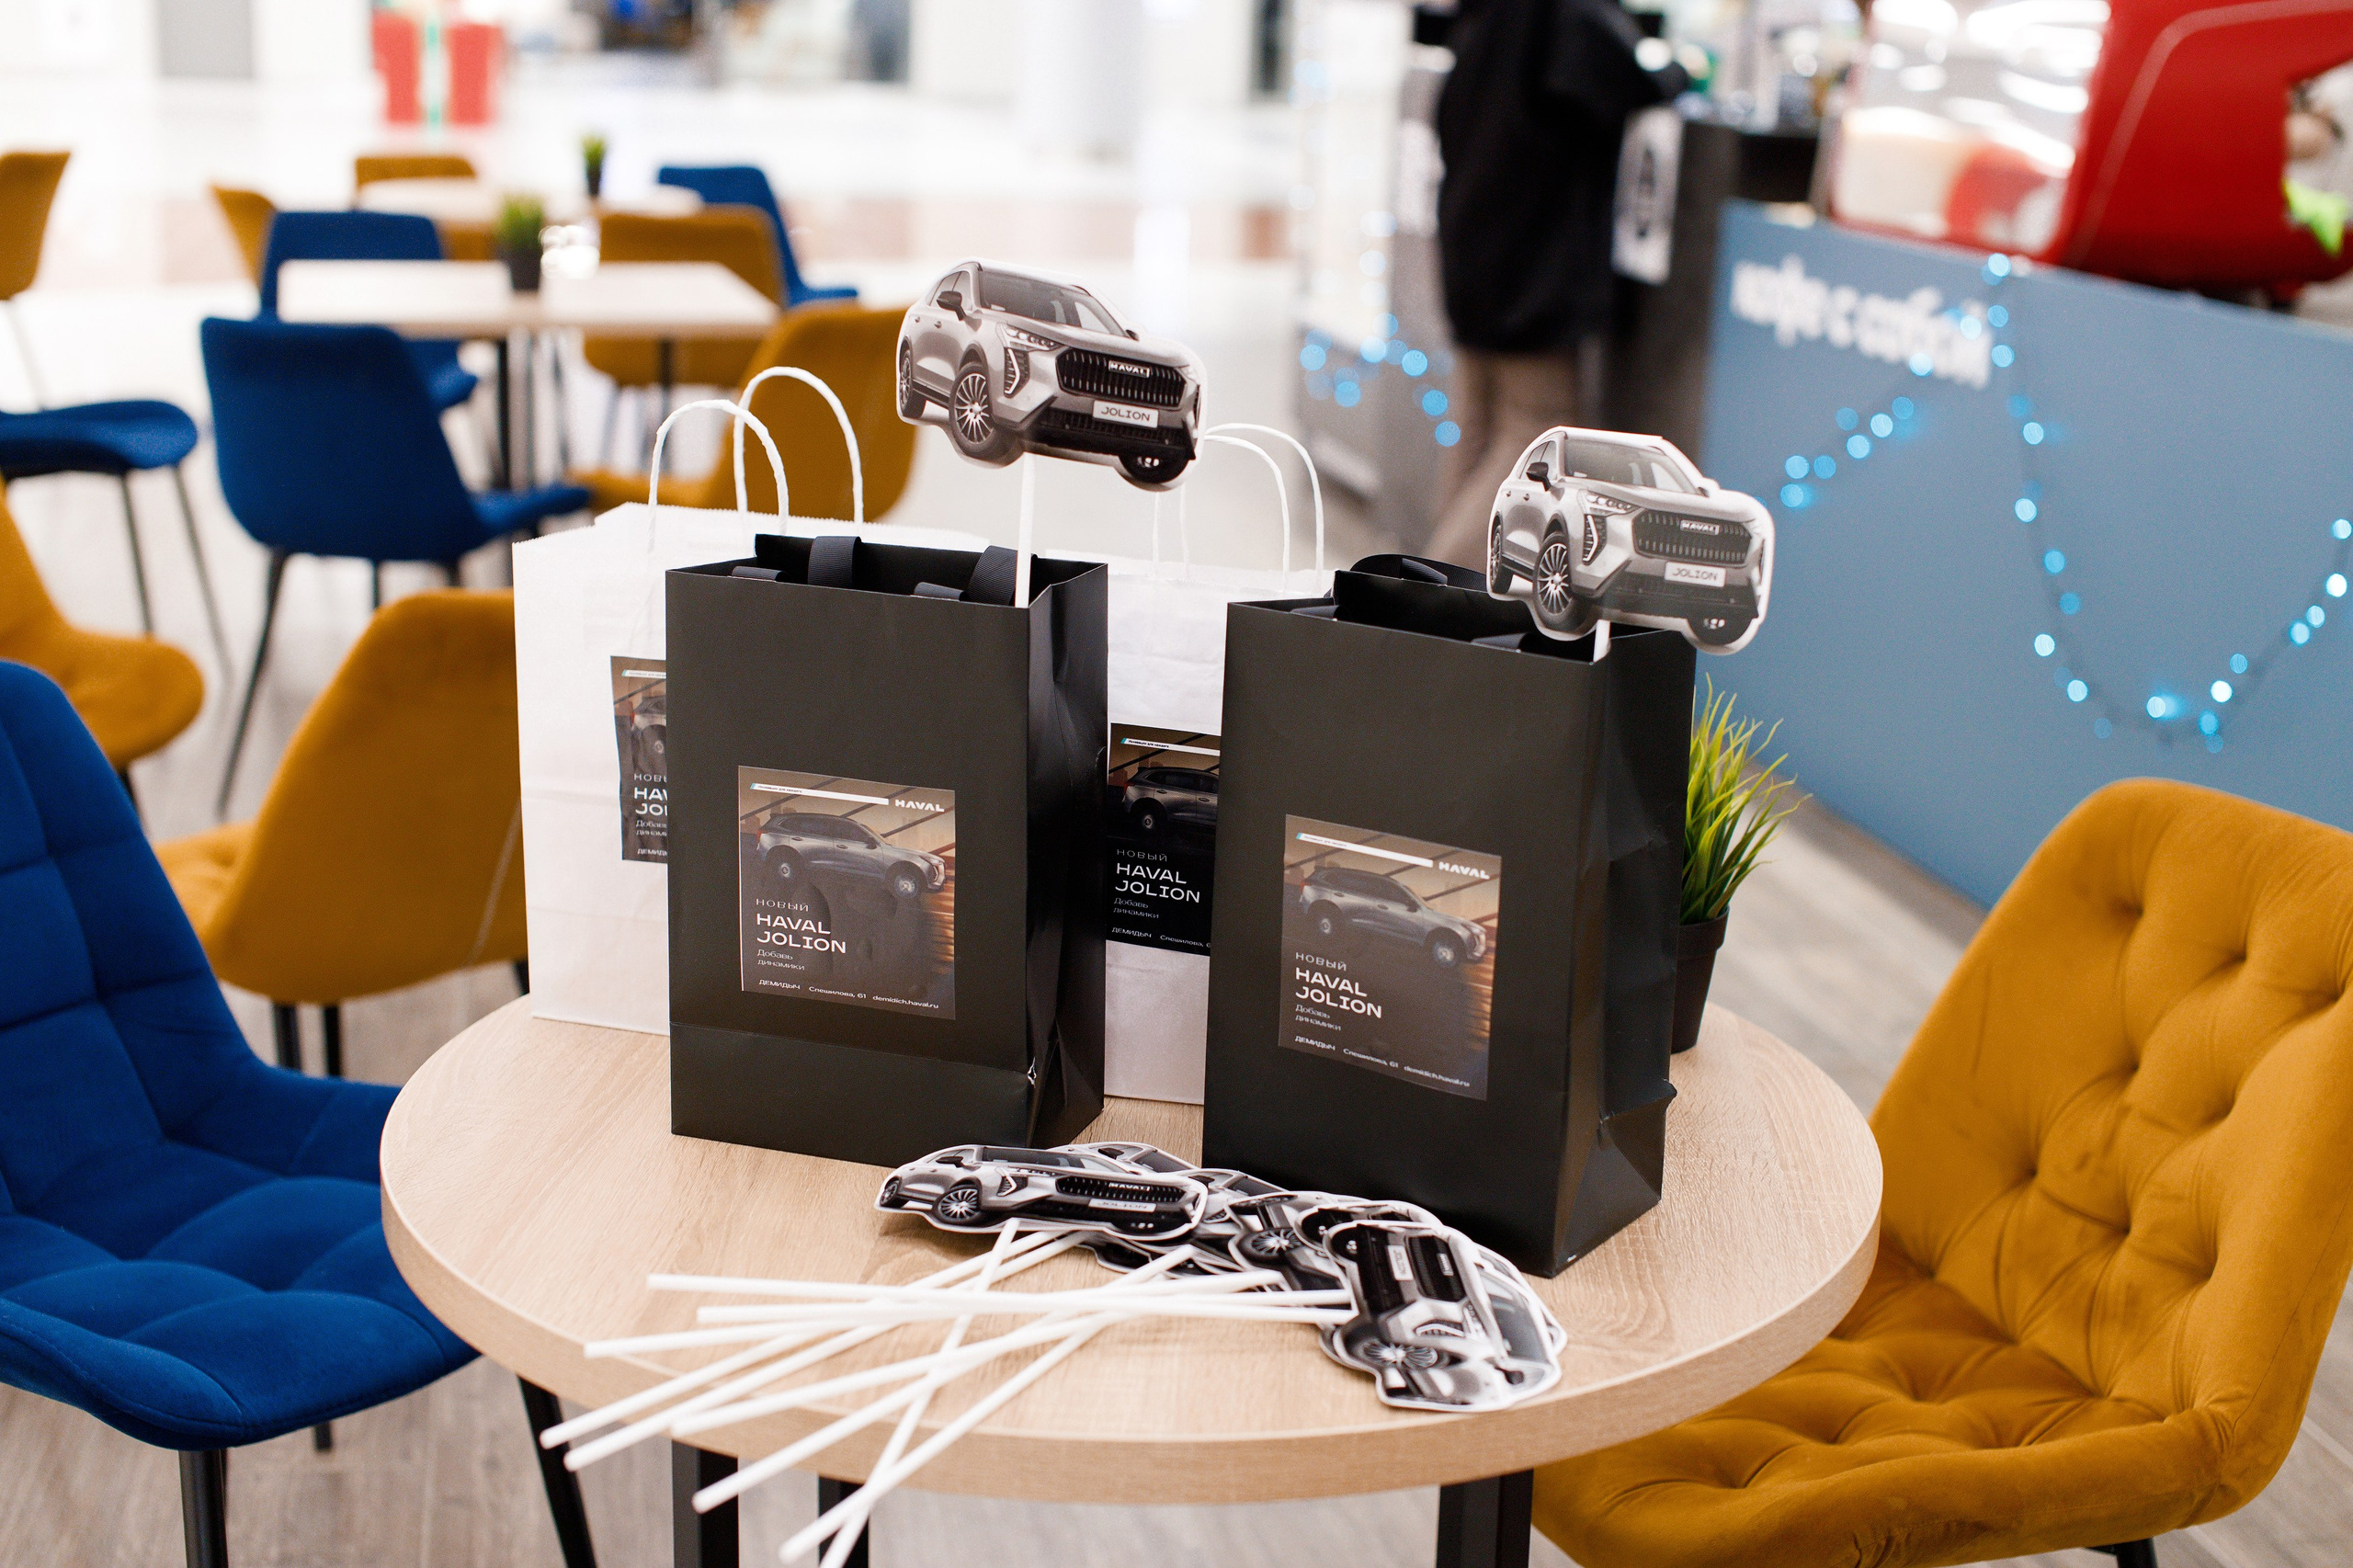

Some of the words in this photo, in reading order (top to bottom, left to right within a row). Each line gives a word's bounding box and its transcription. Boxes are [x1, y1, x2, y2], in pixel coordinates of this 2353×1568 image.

[1109, 361, 1147, 375] HAVAL
[1101, 406, 1150, 422] JOLION
[1673, 568, 1718, 581] JOLION
[633, 773, 667, 783] НОВ
[895, 799, 945, 812] HAVAL
[1117, 848, 1167, 862] НОВЫЙ
[1116, 862, 1187, 884] HAVAL
[1438, 861, 1491, 880] HAVAL
[1115, 880, 1200, 903] JOLION
[756, 898, 809, 912] НОВЫЙ
[1114, 897, 1149, 908] Добавь
[1113, 907, 1159, 919] динамики
[756, 913, 831, 935] HAVAL
[1111, 926, 1152, 938] ДЕМИДЫЧ
[756, 931, 846, 954] JOLION
[756, 949, 793, 960] Добавь
[1295, 951, 1347, 971] НОВЫЙ
[757, 959, 805, 971] динамики
[759, 979, 801, 990] ДЕМИДЫЧ
[1295, 967, 1368, 997] HAVAL
[1295, 986, 1381, 1018] JOLION
[1295, 1004, 1331, 1019] Добавь
[1294, 1035, 1336, 1051] ДЕМИДЫЧ
